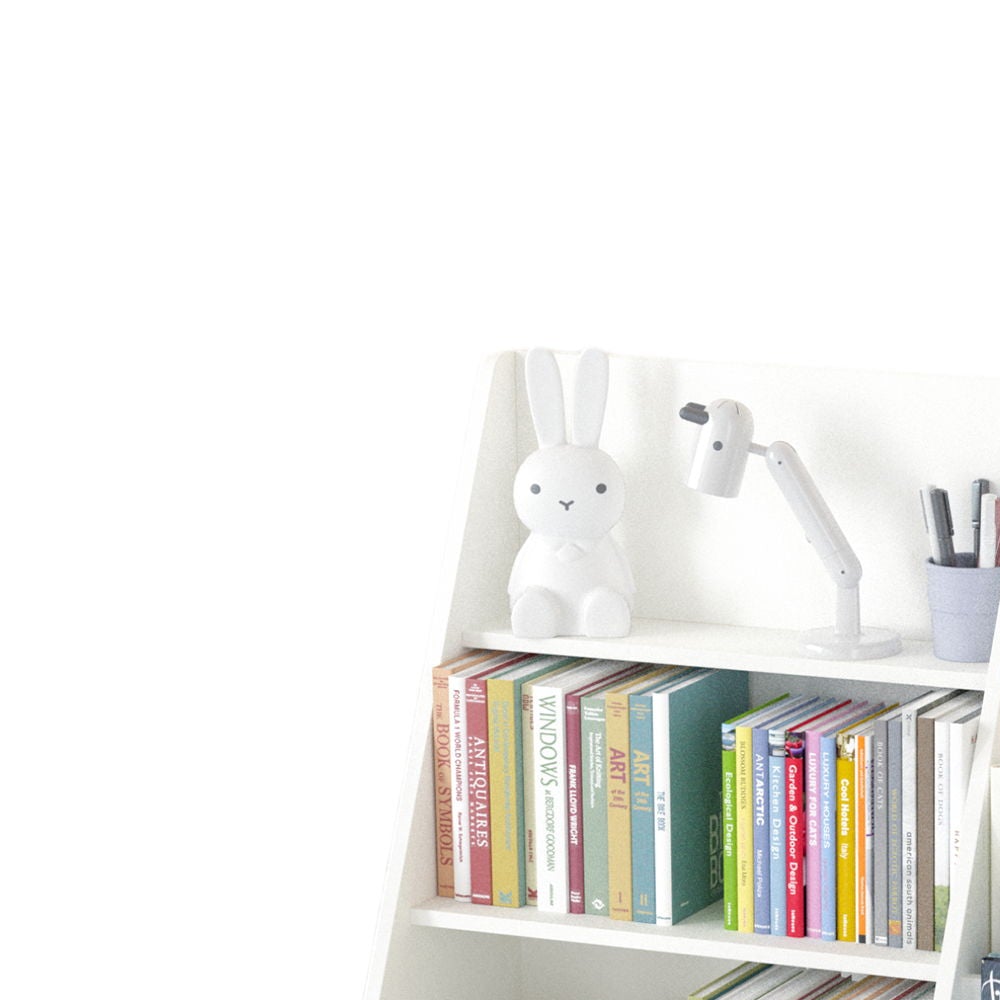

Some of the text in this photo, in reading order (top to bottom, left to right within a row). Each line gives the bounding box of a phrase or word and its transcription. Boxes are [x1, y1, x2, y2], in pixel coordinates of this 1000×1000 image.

[437, 724, 451, 767] BOOK
[453, 689, 461, 724] FORMULA
[539, 694, 558, 787] WINDOWS
[471, 736, 489, 848] ANTIQUAIRES
[568, 764, 579, 845] FRANK LLOYD WRIGHT
[609, 747, 626, 784] ART
[633, 749, 651, 786] ART
[755, 754, 764, 826] ANTARCTIC
[809, 752, 817, 847] LUXURY FOR CATS
[822, 752, 831, 849] LUXURY HOUSES
[840, 778, 850, 802] Cool
[438, 786, 453, 867] SYMBOLS
[724, 772, 734, 857] Ecological Design
[771, 765, 783, 860] Kitchen Design
[788, 764, 799, 895] Garden & Outdoor Design
[840, 803, 850, 836] Hotels
[905, 831, 914, 945] american south animals
